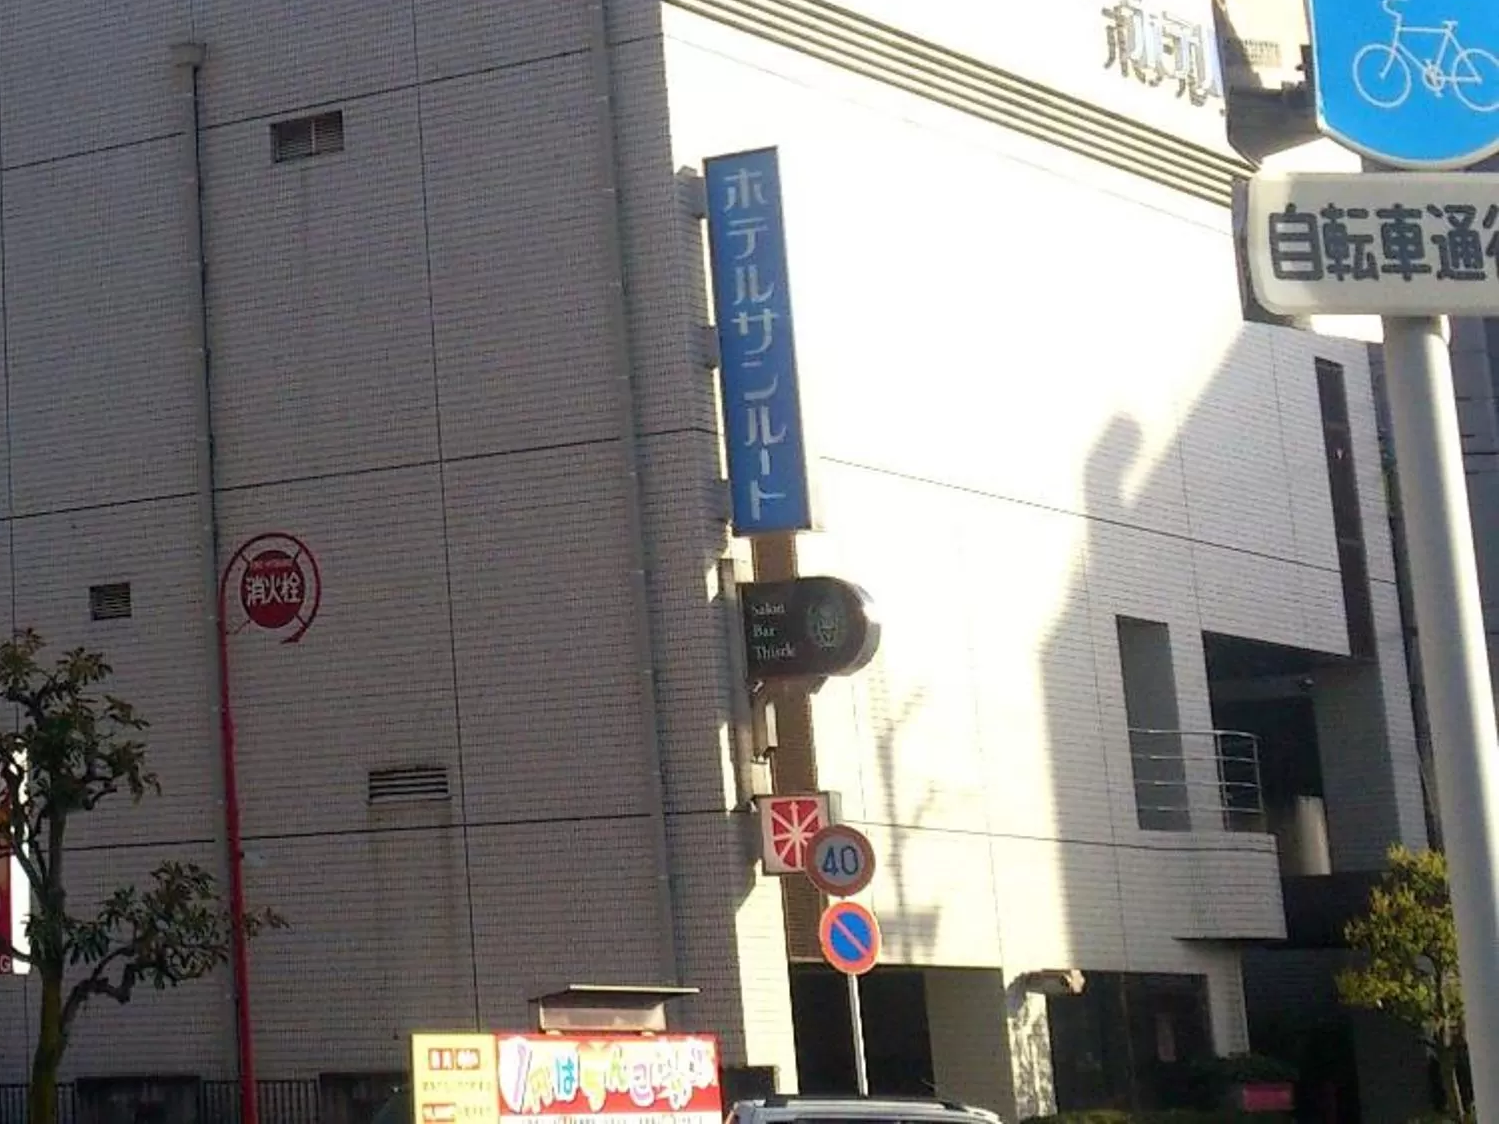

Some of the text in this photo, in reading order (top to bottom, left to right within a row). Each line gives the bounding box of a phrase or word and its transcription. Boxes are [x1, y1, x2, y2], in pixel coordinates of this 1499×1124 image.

[723, 167, 788, 522] ホテルサンルート
[821, 844, 861, 877] 40
